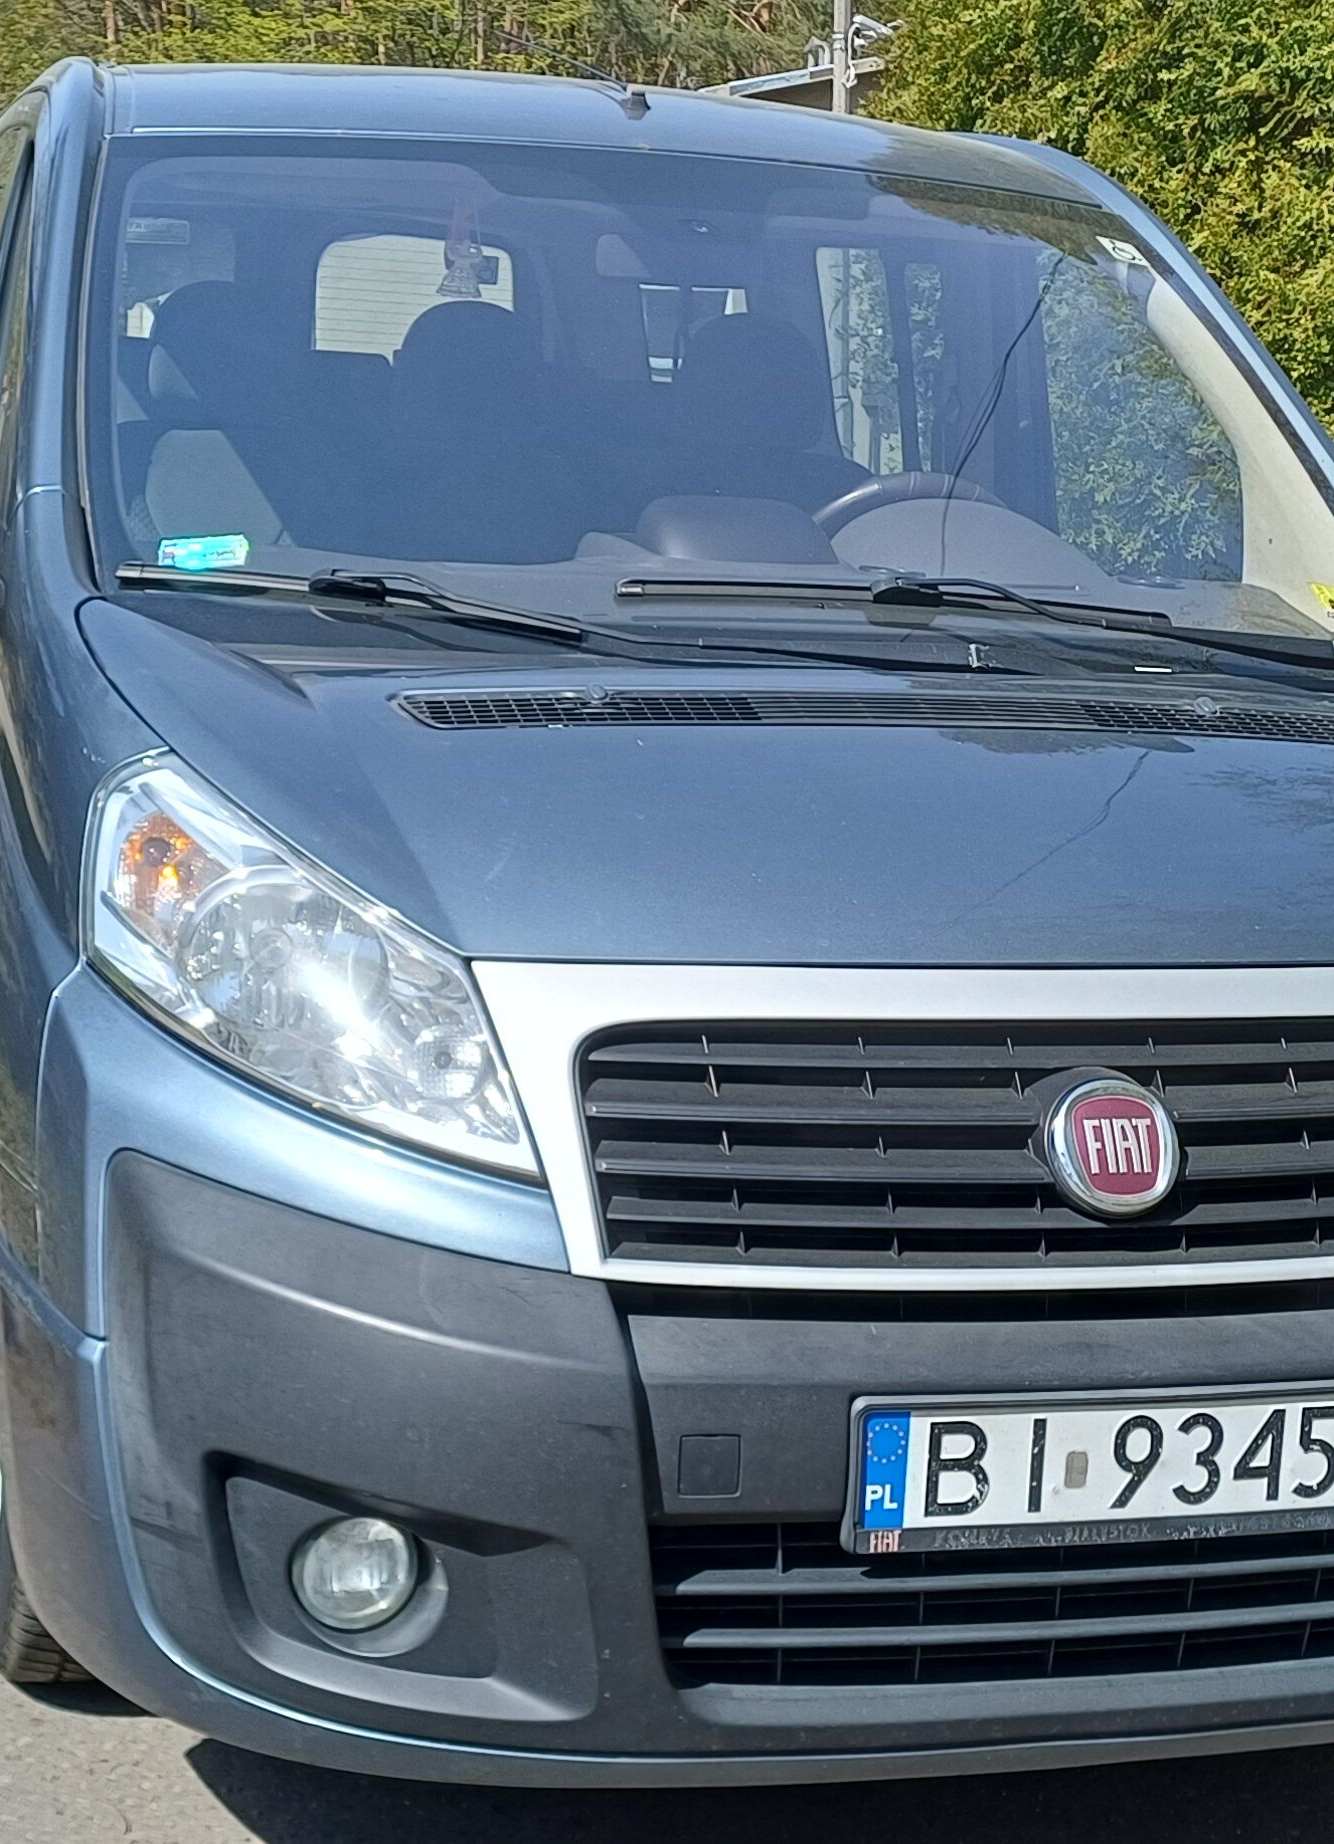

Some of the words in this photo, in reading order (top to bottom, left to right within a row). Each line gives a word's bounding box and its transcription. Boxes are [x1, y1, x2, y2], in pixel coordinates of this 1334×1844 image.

[1083, 1118, 1152, 1175] FIAT
[924, 1418, 1047, 1517] BI
[865, 1484, 898, 1510] PL
[869, 1530, 902, 1553] FIAT
